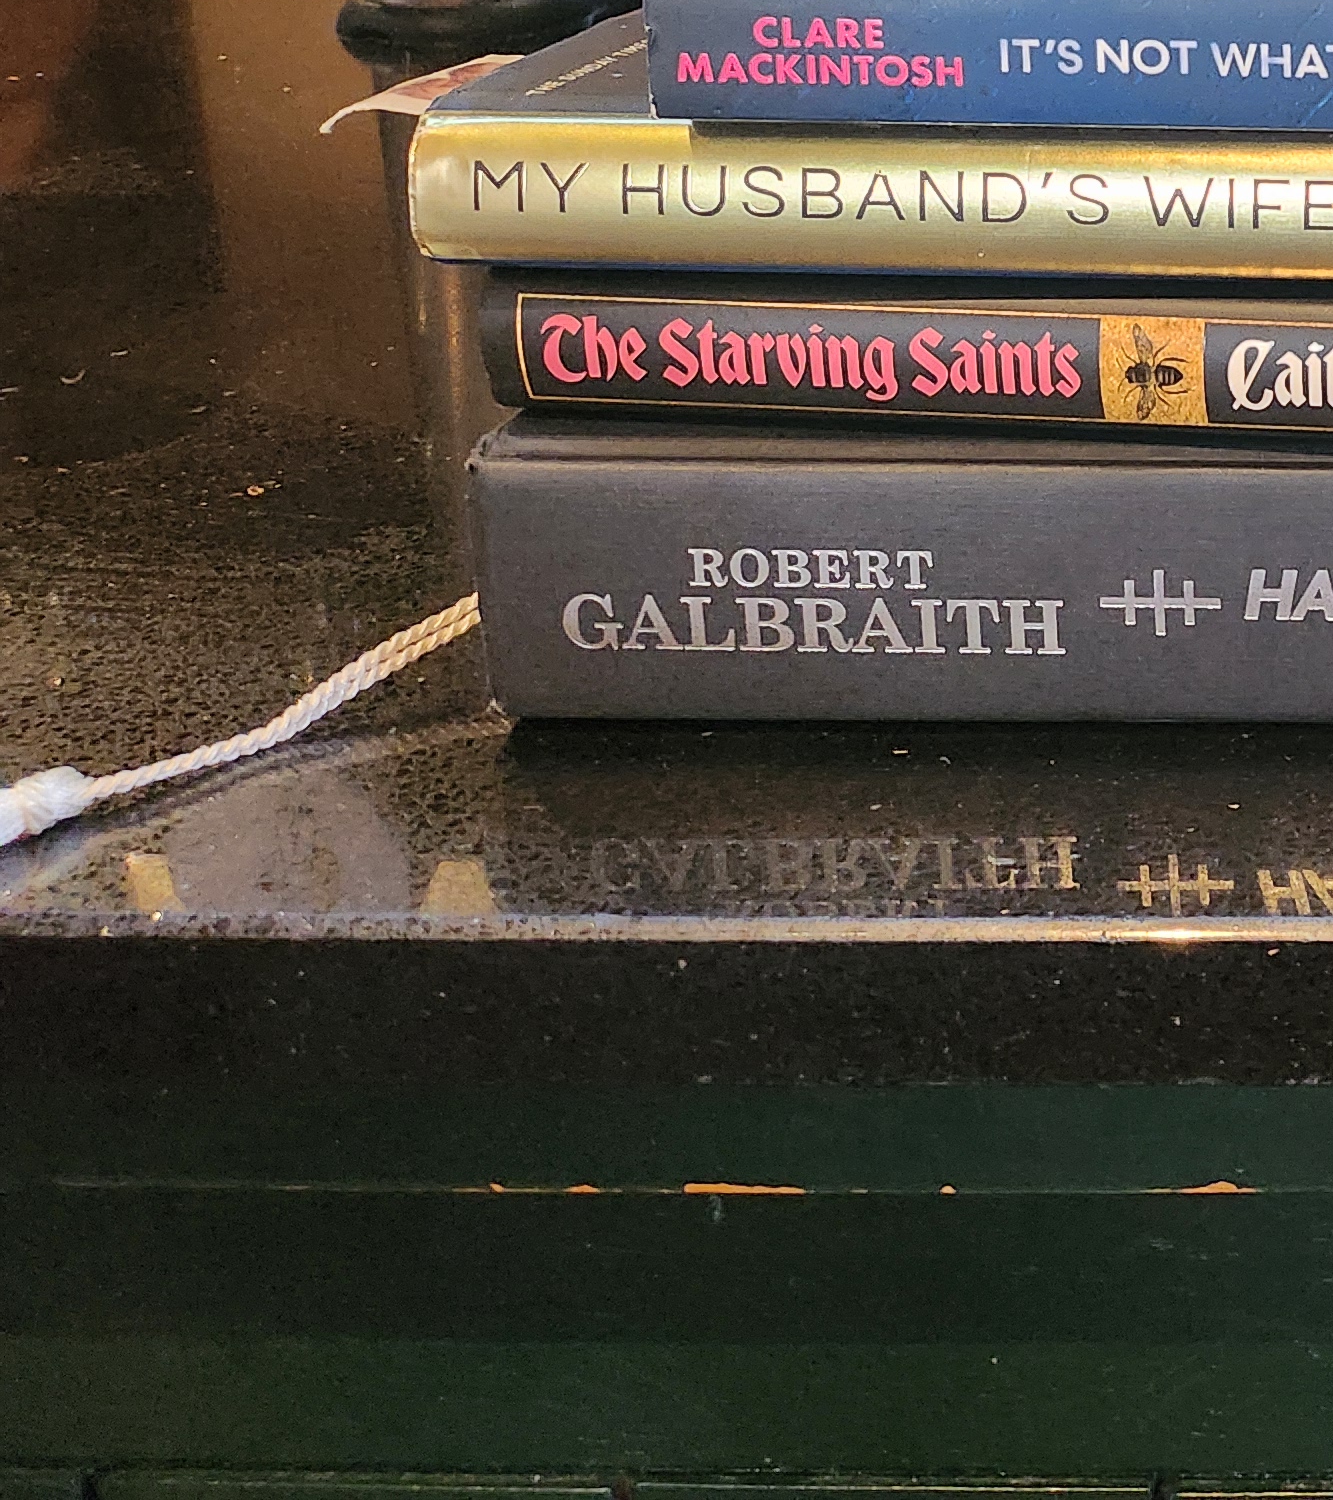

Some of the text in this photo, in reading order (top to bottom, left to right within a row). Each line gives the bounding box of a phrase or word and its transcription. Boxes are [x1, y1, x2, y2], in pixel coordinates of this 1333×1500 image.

[753, 16, 885, 50] CLARE
[676, 53, 965, 88] MACKINTOSH
[999, 38, 1084, 76] IT'S
[1096, 39, 1198, 76] NOT
[472, 159, 590, 213] MY
[620, 161, 1110, 226] HUSBAND'S
[540, 312, 1082, 403] The Starving Saints
[688, 548, 935, 590] ROBERT
[561, 591, 1067, 656] GALBRAITH
